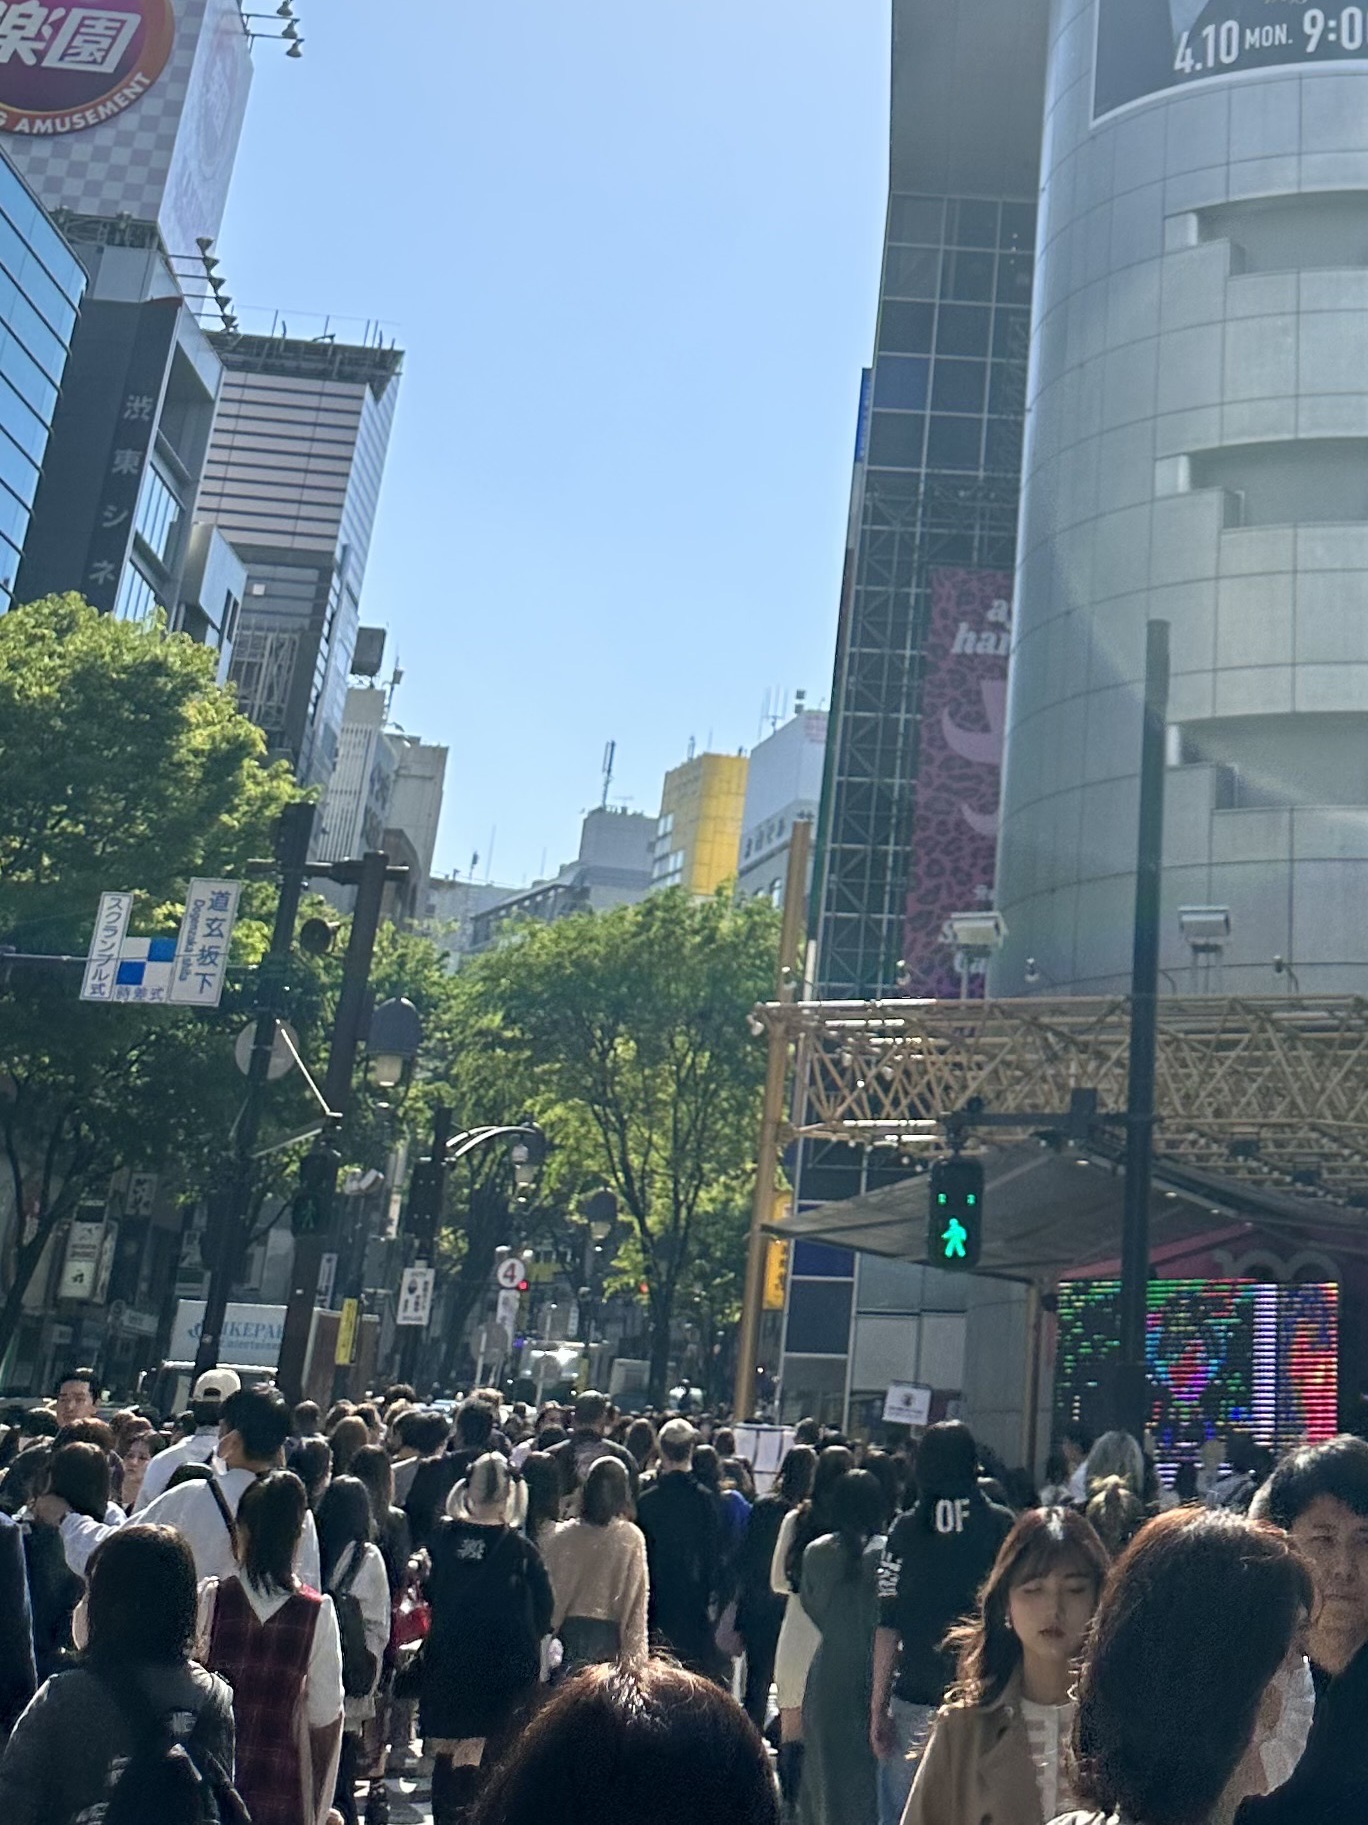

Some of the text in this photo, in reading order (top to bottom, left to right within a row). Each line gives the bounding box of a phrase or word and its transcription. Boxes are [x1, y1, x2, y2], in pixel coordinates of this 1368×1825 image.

[1174, 20, 1240, 73] 4.10
[1244, 24, 1293, 50] MON.
[14, 72, 151, 135] AMUSEMENT
[194, 889, 232, 995] 道玄坂下
